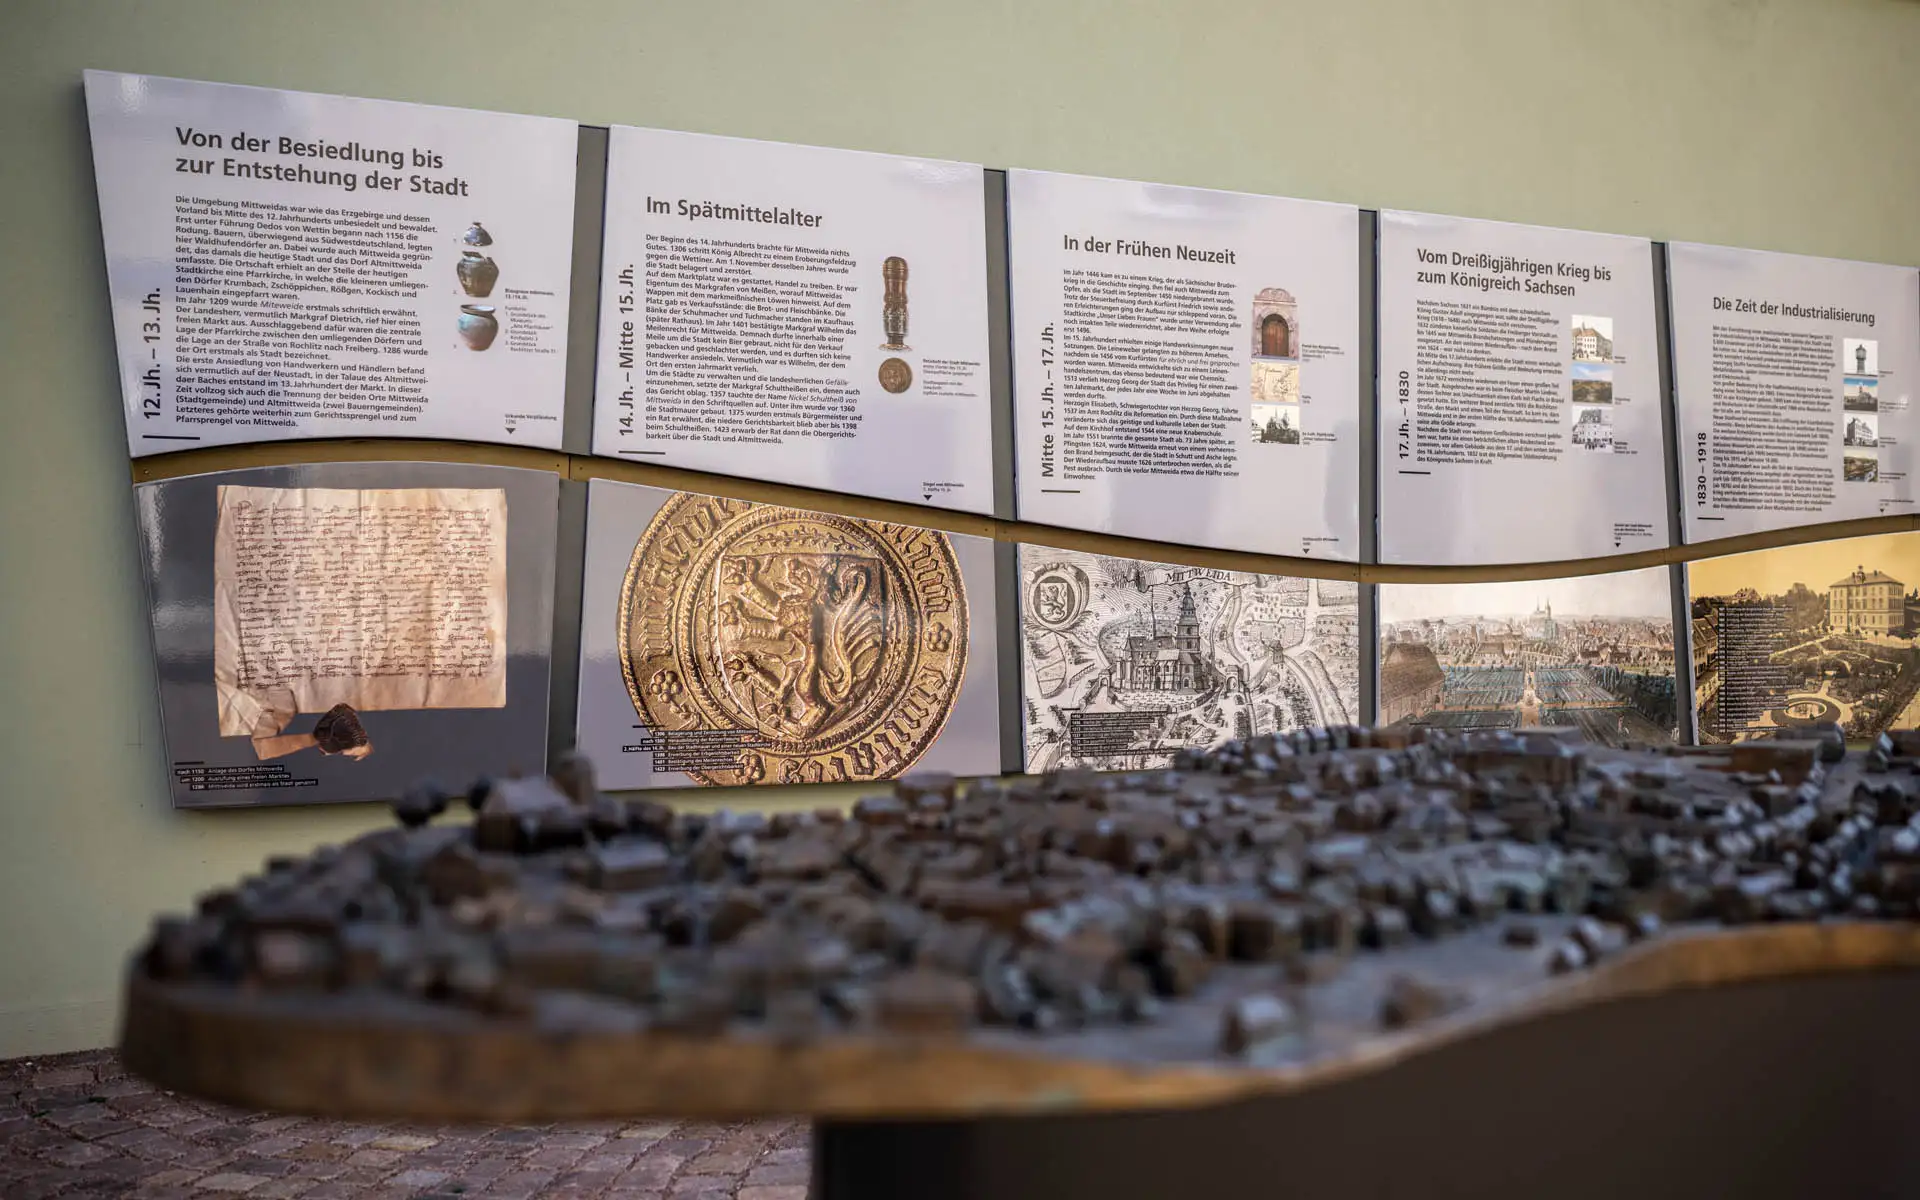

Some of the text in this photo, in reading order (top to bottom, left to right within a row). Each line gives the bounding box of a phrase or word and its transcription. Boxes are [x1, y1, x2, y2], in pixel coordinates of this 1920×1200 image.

[176, 127, 443, 169] Von der Besiedlung bis
[176, 158, 468, 196] zur Entstehung der Stadt
[175, 195, 190, 204] Die
[191, 196, 238, 209] Umgebung
[240, 200, 287, 211] Mittweidas
[307, 205, 323, 214] wie
[324, 206, 339, 215] das
[341, 208, 384, 220] Erzgebirge
[385, 211, 401, 220] und
[403, 212, 430, 222] dessen
[646, 196, 822, 228] Im Spätmittelalter
[175, 215, 192, 224] Erst
[193, 216, 217, 225] unter
[219, 218, 254, 230] Führung
[256, 221, 282, 230] Dedos
[302, 224, 330, 234] Wettin
[331, 226, 362, 238] begann
[364, 229, 383, 238] nach
[385, 231, 404, 239] 1156
[405, 232, 418, 240] die
[175, 225, 210, 237] Rodung.
[213, 228, 245, 238] Bauern,
[248, 230, 303, 243] überwiegend
[320, 235, 405, 250] Südwestdeutschland,
[407, 242, 432, 253] legten
[645, 242, 669, 251] Gutes.
[688, 246, 709, 254] schritt
[711, 248, 731, 258] König
[733, 249, 762, 258] Albrecht
[772, 253, 793, 261] einem
[794, 254, 856, 268] Eroberungsfeldzug
[1063, 234, 1236, 265] In der Frühen Neuzeit
[175, 255, 216, 265] umfasste.
[218, 258, 233, 266] Die
[234, 259, 274, 269] Ortschaft
[275, 261, 303, 271] erhielt
[317, 264, 330, 273] der
[332, 265, 355, 274] Stelle
[357, 267, 370, 275] der
[372, 268, 408, 280] heutigen
[658, 261, 677, 270] Stadt
[678, 263, 707, 273] belagert
[709, 265, 723, 273] und
[724, 266, 752, 275] zerstört.
[1417, 248, 1611, 282] Vom Dreißigjährigen Krieg bis
[1416, 271, 1575, 296] zum Königreich Sachsen
[1712, 297, 1875, 326] Die Zeit der Industrialisierung
[175, 414, 232, 426] Pfarrsprengel
[253, 417, 299, 427] Mittweida.
[645, 431, 670, 439] barkeit
[737, 435, 784, 444] Altmittweida.
